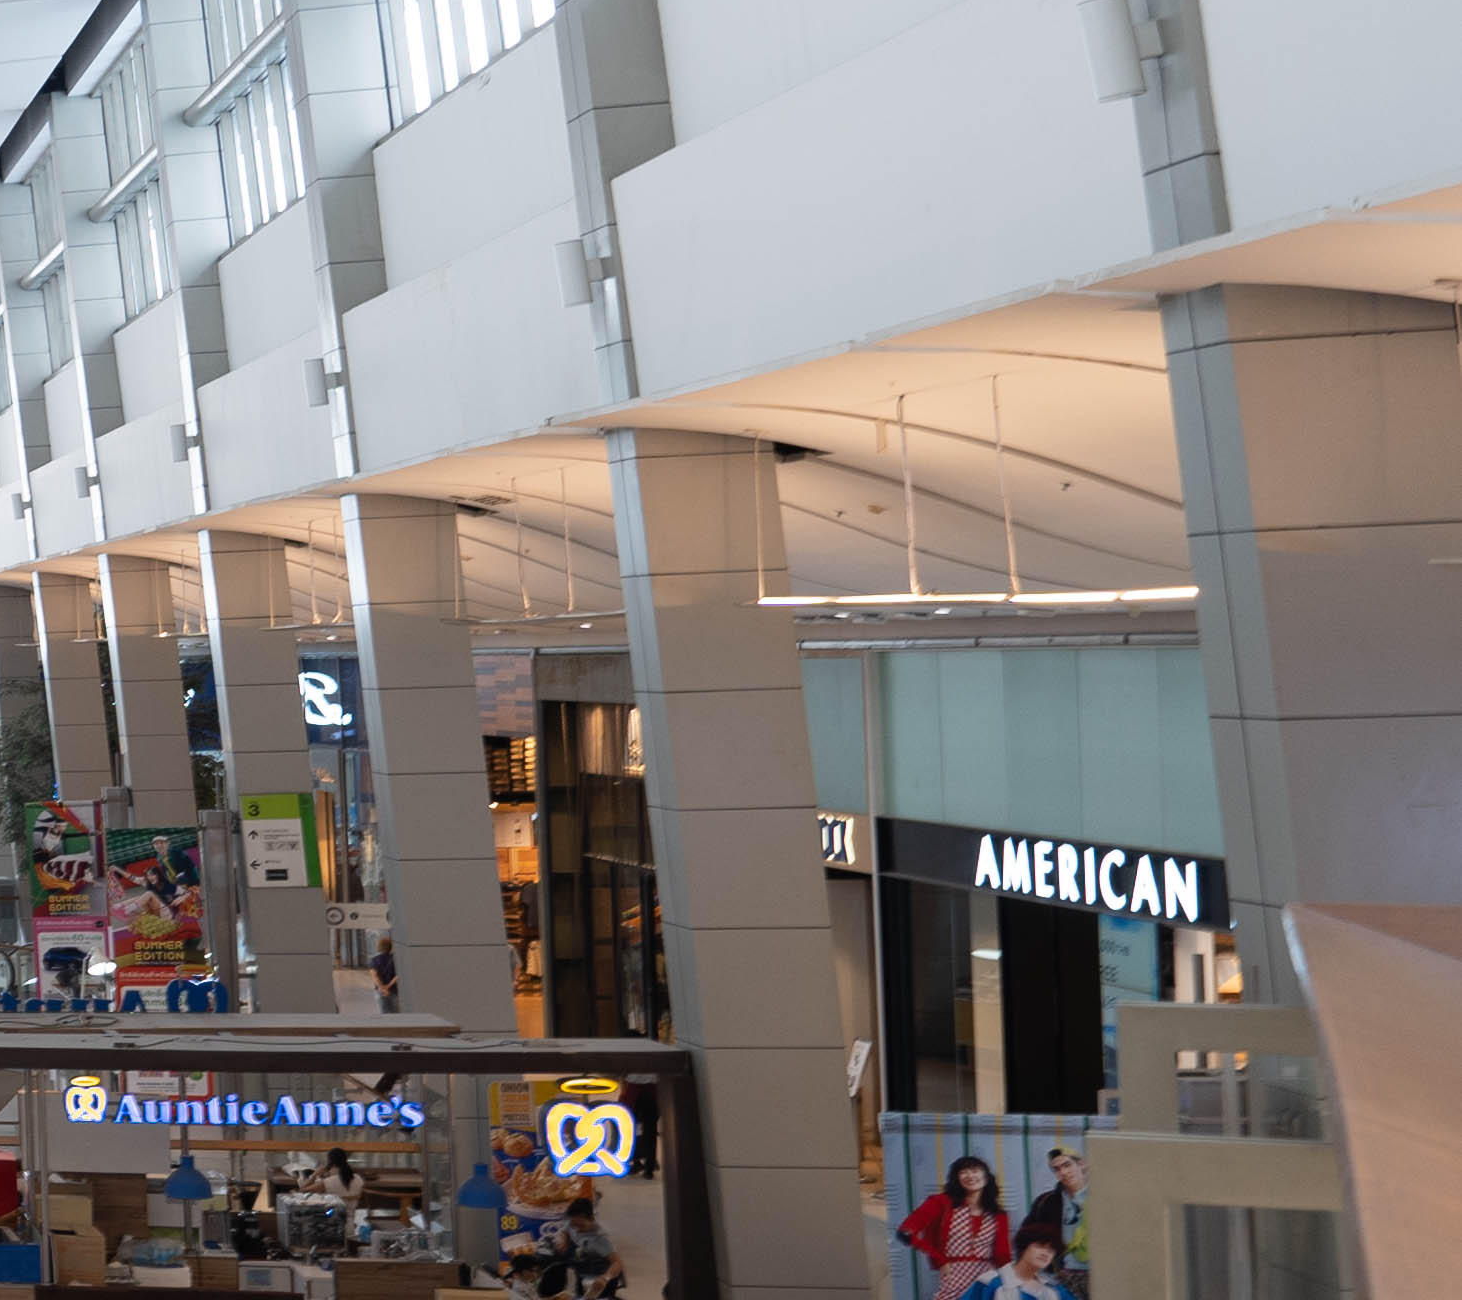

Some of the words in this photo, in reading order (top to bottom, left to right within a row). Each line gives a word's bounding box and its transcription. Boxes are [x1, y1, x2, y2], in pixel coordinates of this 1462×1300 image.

[248, 804, 261, 817] 3
[974, 833, 1199, 924] AMERICAN
[134, 940, 185, 950] SUMMER
[134, 951, 185, 961] EDITION
[114, 1093, 269, 1126] Auntie
[271, 1094, 426, 1128] Anne's
[500, 1215, 519, 1231] 89
